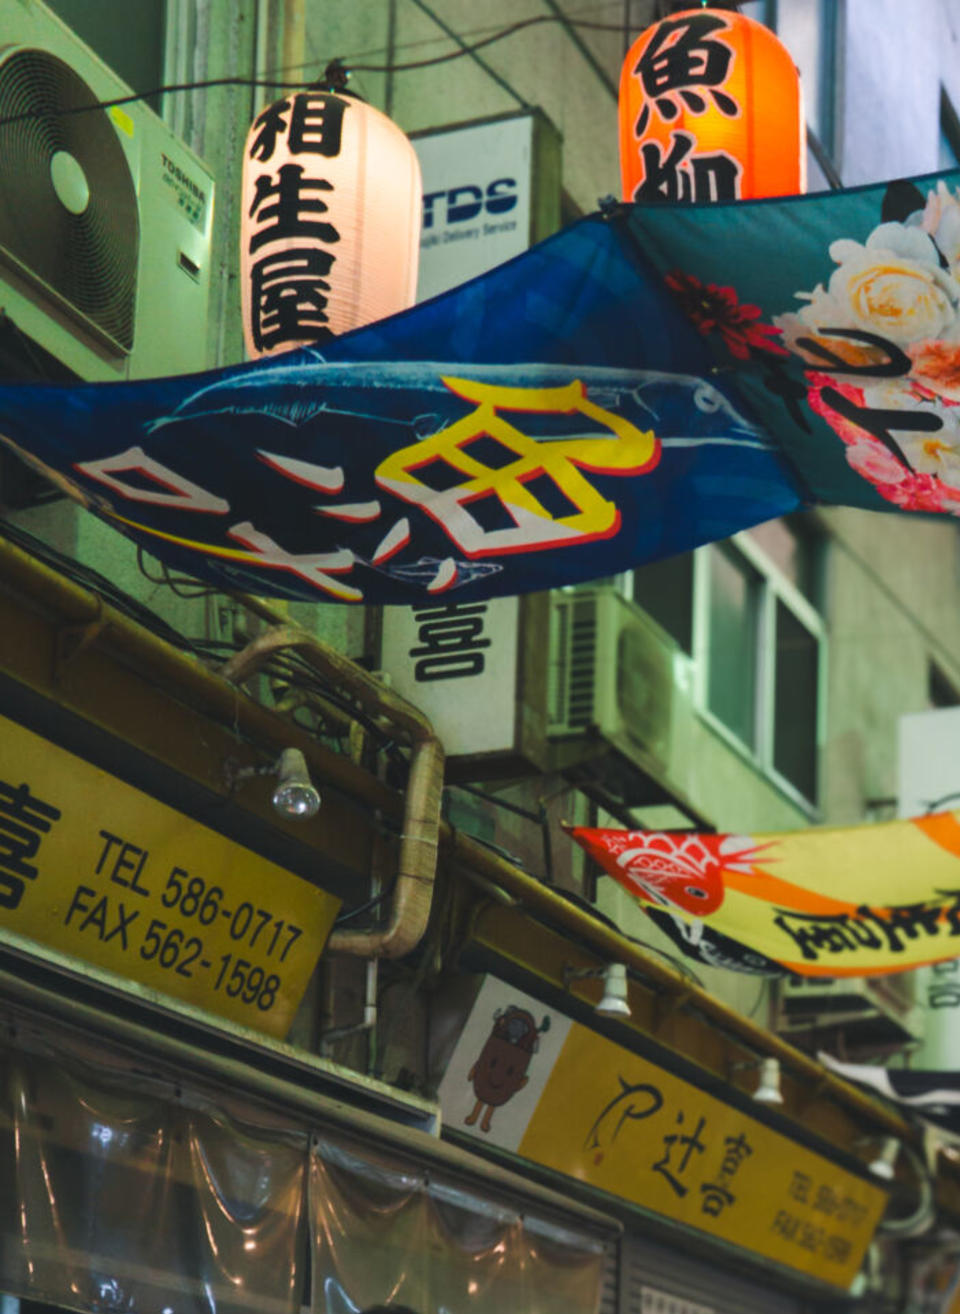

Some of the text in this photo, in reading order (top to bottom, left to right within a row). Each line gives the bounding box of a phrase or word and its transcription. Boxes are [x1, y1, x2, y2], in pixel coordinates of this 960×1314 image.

[161, 152, 206, 204] TOSHIBA
[249, 91, 350, 353] 相生屋
[422, 177, 518, 228] TDS
[63, 884, 282, 1012] FAX 562-1598
[95, 828, 304, 964] TEL 586-0717
